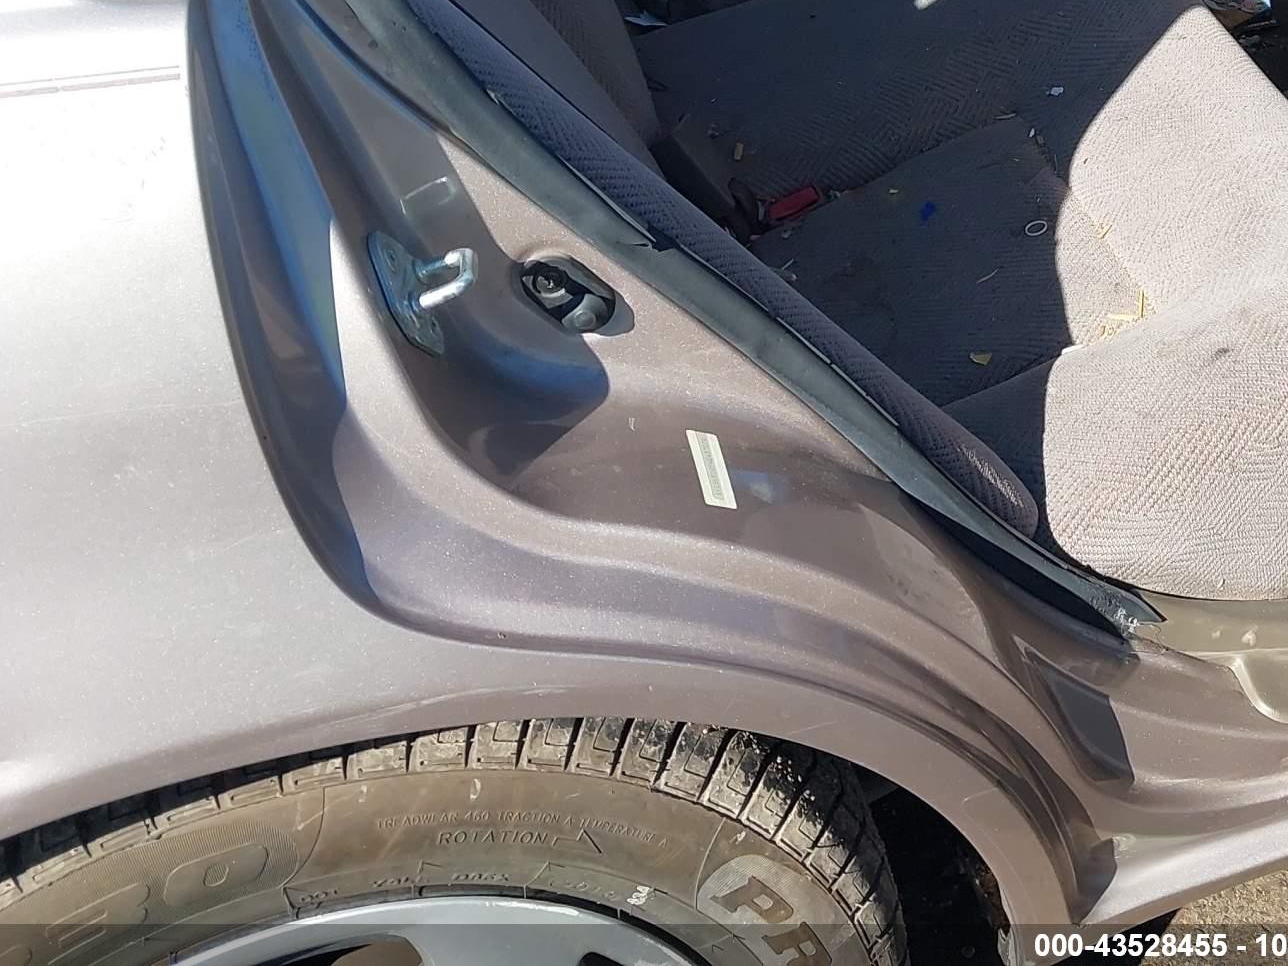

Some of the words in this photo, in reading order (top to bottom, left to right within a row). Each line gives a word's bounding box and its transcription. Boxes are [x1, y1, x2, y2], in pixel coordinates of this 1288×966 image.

[376, 811, 459, 829] TREADWEAR
[463, 810, 490, 822] 460
[498, 810, 561, 824] TRACTION
[564, 815, 574, 826] A
[580, 817, 656, 843] TEMPERATURE
[658, 838, 669, 848] A
[436, 829, 548, 845] ROTATION
